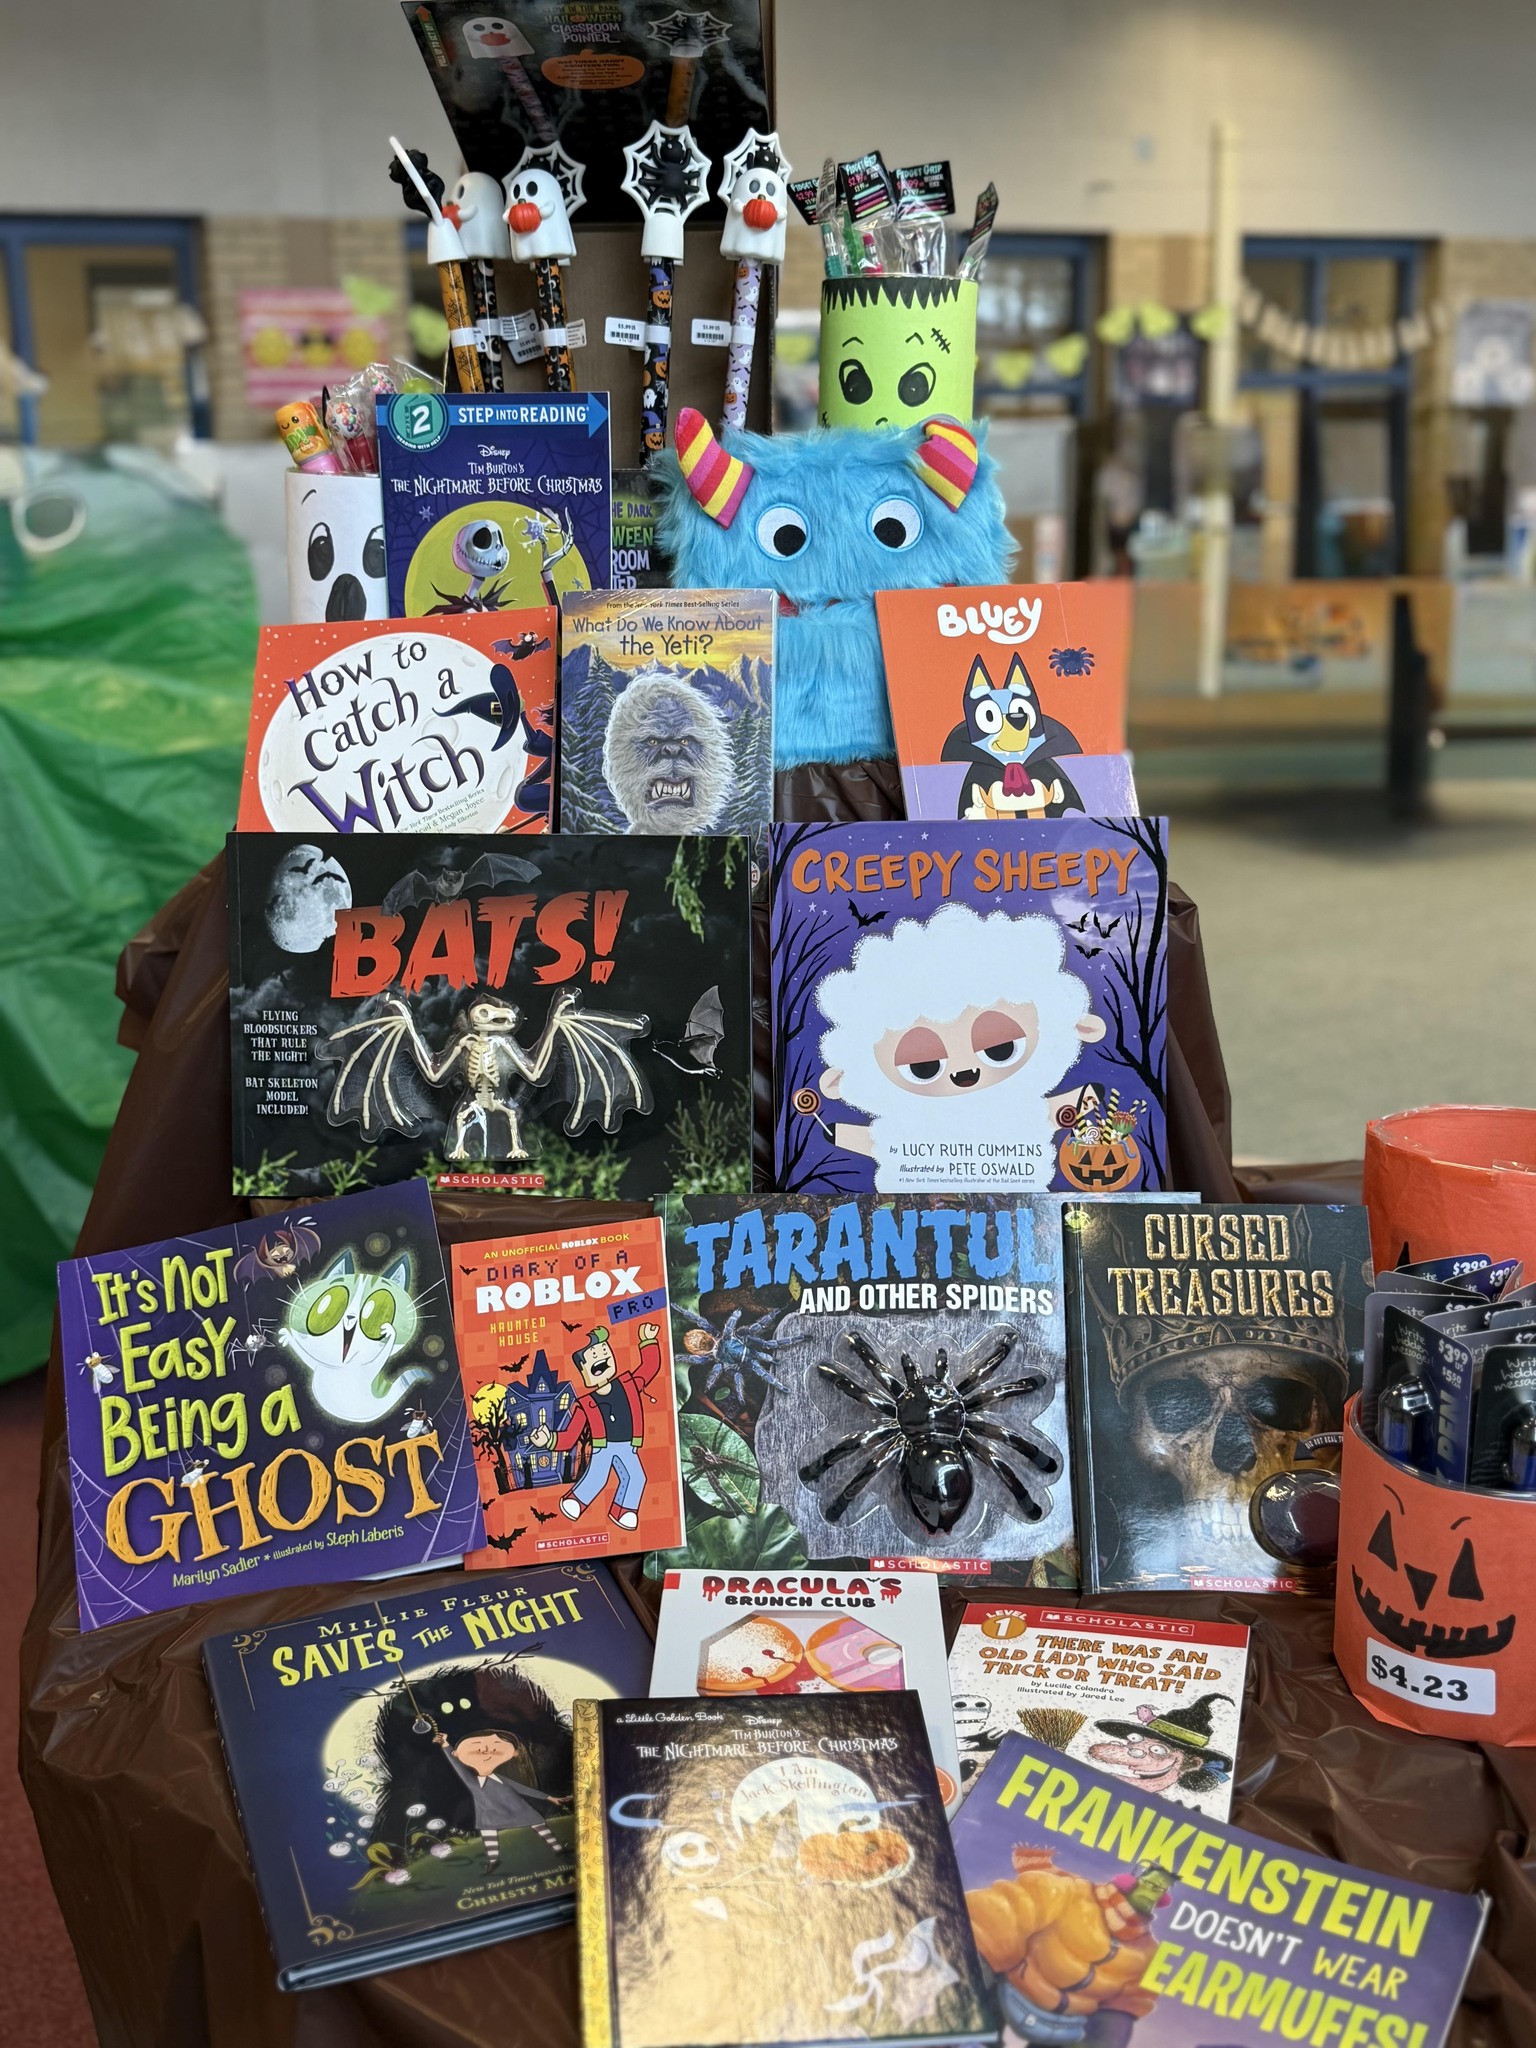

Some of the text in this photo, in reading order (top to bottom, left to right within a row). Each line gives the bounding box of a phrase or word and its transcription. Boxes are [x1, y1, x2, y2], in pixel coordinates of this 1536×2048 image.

[551, 23, 620, 33] CLASSROOM
[563, 33, 620, 43] POINTER
[924, 165, 942, 174] GRIP
[412, 405, 431, 435] 2
[459, 407, 587, 423] STEP INTO READING
[431, 435, 441, 446] HELP
[478, 444, 511, 459] Disney
[468, 462, 524, 475] TIM BURTON'S
[391, 475, 603, 496] THE NIGHTMARE BEFORE CHRISTMAS
[627, 503, 653, 518] DARK
[573, 616, 763, 633] What Do We Know About
[937, 597, 1042, 644] BLUEY
[620, 634, 714, 655] the Yeti?
[284, 641, 427, 721] How to
[304, 668, 460, 772] Catch a
[287, 734, 485, 833] Witch
[440, 798, 485, 823] Megan Joyce
[445, 822, 456, 831] Andy
[791, 849, 962, 899] CREEPY
[973, 848, 1140, 898] SHEEPY
[331, 890, 629, 997] BATS!
[263, 1010, 298, 1021] FLYING
[244, 1024, 317, 1035] BLOODSUCKERS
[251, 1037, 307, 1048] THAT RULE
[251, 1051, 307, 1062] THE NIGHT!
[245, 1077, 318, 1089] BAT SKELETON
[266, 1091, 298, 1101] MODEL
[257, 1104, 309, 1114] INCLUDED!
[889, 1144, 1042, 1156] by LUCY RUTH CUMMINS
[936, 1163, 1034, 1175] by PETE OSWALD
[452, 1174, 544, 1186] SCHOLASTIC
[502, 1243, 560, 1256] UNOFFICIAL
[562, 1238, 598, 1249] ROBLOX
[601, 1234, 629, 1244] BOOK
[1144, 1214, 1290, 1262] CURSED
[487, 1251, 627, 1281] DIARY OF A
[91, 1269, 157, 1326] It's
[476, 1266, 643, 1314] ROBLOX
[800, 1283, 1053, 1315] AND OTHER SPIDERS
[1108, 1267, 1334, 1317] TREASURES
[613, 1296, 653, 1319] PRO
[490, 1316, 546, 1334] HAUNTED
[1399, 1324, 1425, 1344] Write
[499, 1331, 539, 1347] HOUSE
[1396, 1331, 1428, 1353] hidden
[1455, 1363, 1464, 1372] US
[260, 1384, 301, 1436] a
[105, 1431, 443, 1565] GHOST
[547, 1535, 608, 1548] SCHOLASTIC
[172, 1526, 404, 1587] Marilyn Sadler illustrated by Steph Laberis
[887, 1560, 989, 1571] SCHOLASTIC
[702, 1576, 902, 1604] DRACULA'S
[1207, 1579, 1293, 1588] SCHOLASTIC
[725, 1595, 876, 1607] BRUNCH CLUB
[318, 1587, 527, 1639] MILLIE FLEUR
[986, 1610, 1026, 1620] LEVEL
[996, 1617, 1013, 1638] 1
[1064, 1615, 1189, 1634] SCHOLASTIC
[272, 1588, 583, 1686] SAVES THE NIGHT
[1036, 1635, 1104, 1653] THERE
[1112, 1642, 1162, 1659] WAS
[1167, 1649, 1208, 1664] AN
[979, 1647, 1222, 1681] OLD LADY WHO SAID
[983, 1661, 1186, 1694] TRICK OR TREAT!
[1045, 1681, 1072, 1689] Lucille
[1075, 1684, 1115, 1694] Colandro
[1371, 1655, 1469, 1701] $4.23
[1017, 1687, 1064, 1695] Illustrated
[1080, 1692, 1106, 1700] Jared
[625, 1714, 654, 1723] Little
[656, 1713, 694, 1722] Golden
[696, 1712, 724, 1721] Book
[742, 1715, 782, 1726] Disney
[732, 1728, 800, 1740] TIM BURTON'S
[637, 1738, 898, 1760] THE NIGHTMARE BEFORE CHRISTMAS
[741, 1780, 868, 1800] Jack Skellington
[997, 1754, 1432, 1958] FRANKENSTEIN
[462, 1875, 533, 1895] New York Times
[457, 1884, 538, 1910] CHRISTY
[1170, 1901, 1408, 2001] DOESN'T WEAR
[1139, 1940, 1429, 2048] EARMUFFS!
